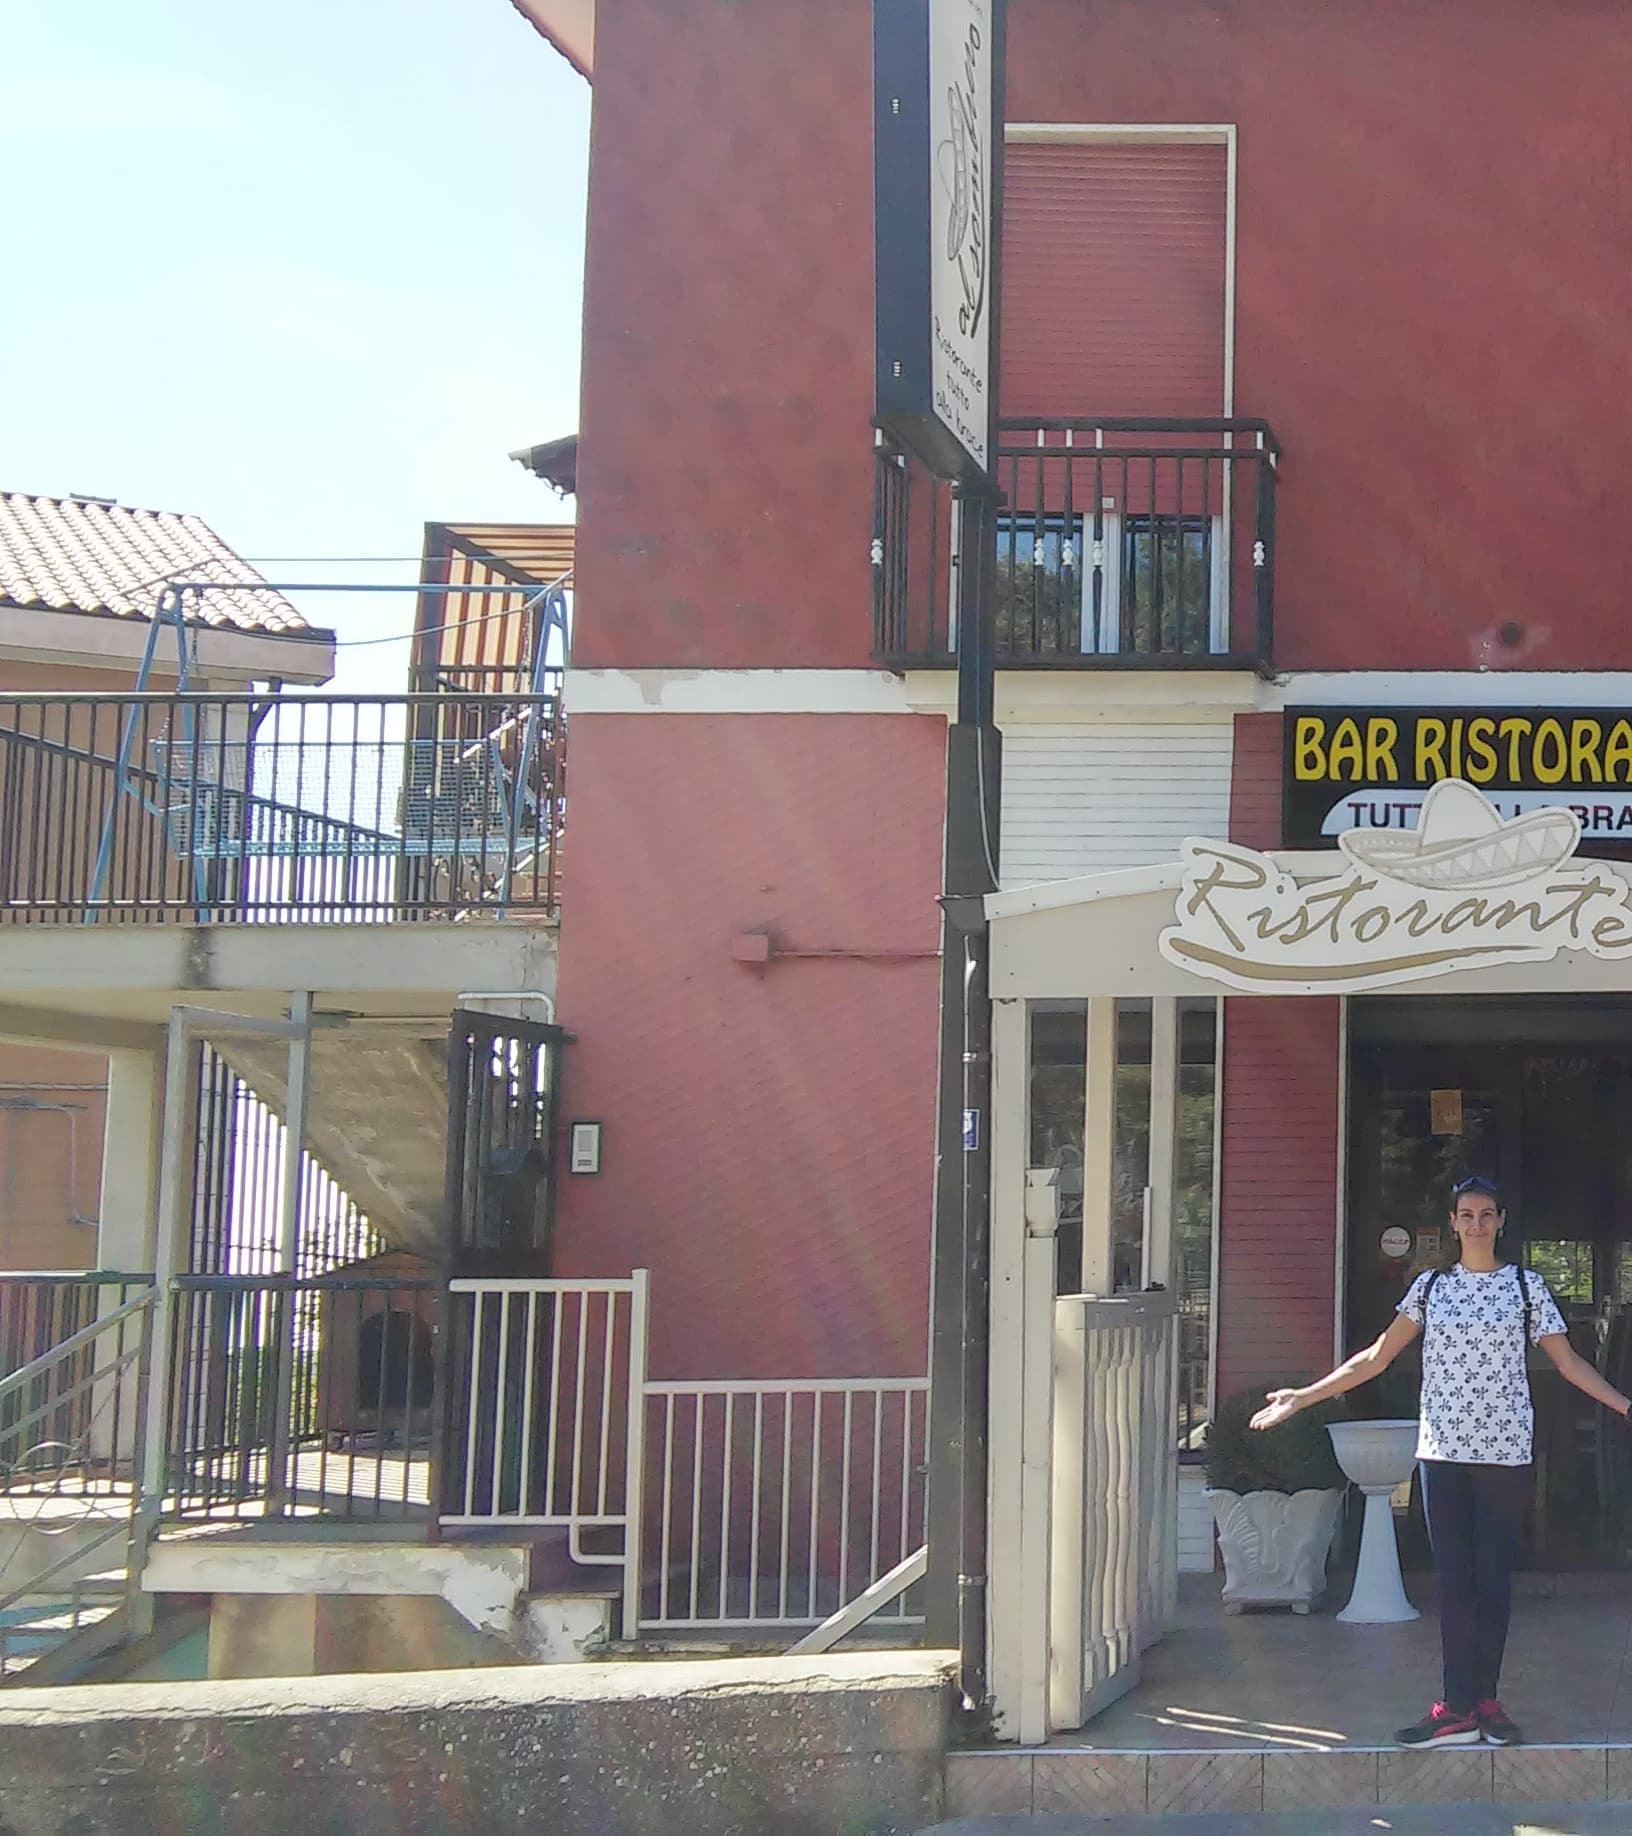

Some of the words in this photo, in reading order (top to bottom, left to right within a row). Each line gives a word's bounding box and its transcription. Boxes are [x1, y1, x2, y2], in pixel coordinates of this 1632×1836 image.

[935, 316, 982, 394] Ristorante
[946, 370, 970, 411] tutto
[936, 391, 952, 419] alla
[956, 407, 984, 458] brace
[1294, 717, 1399, 782] BAR
